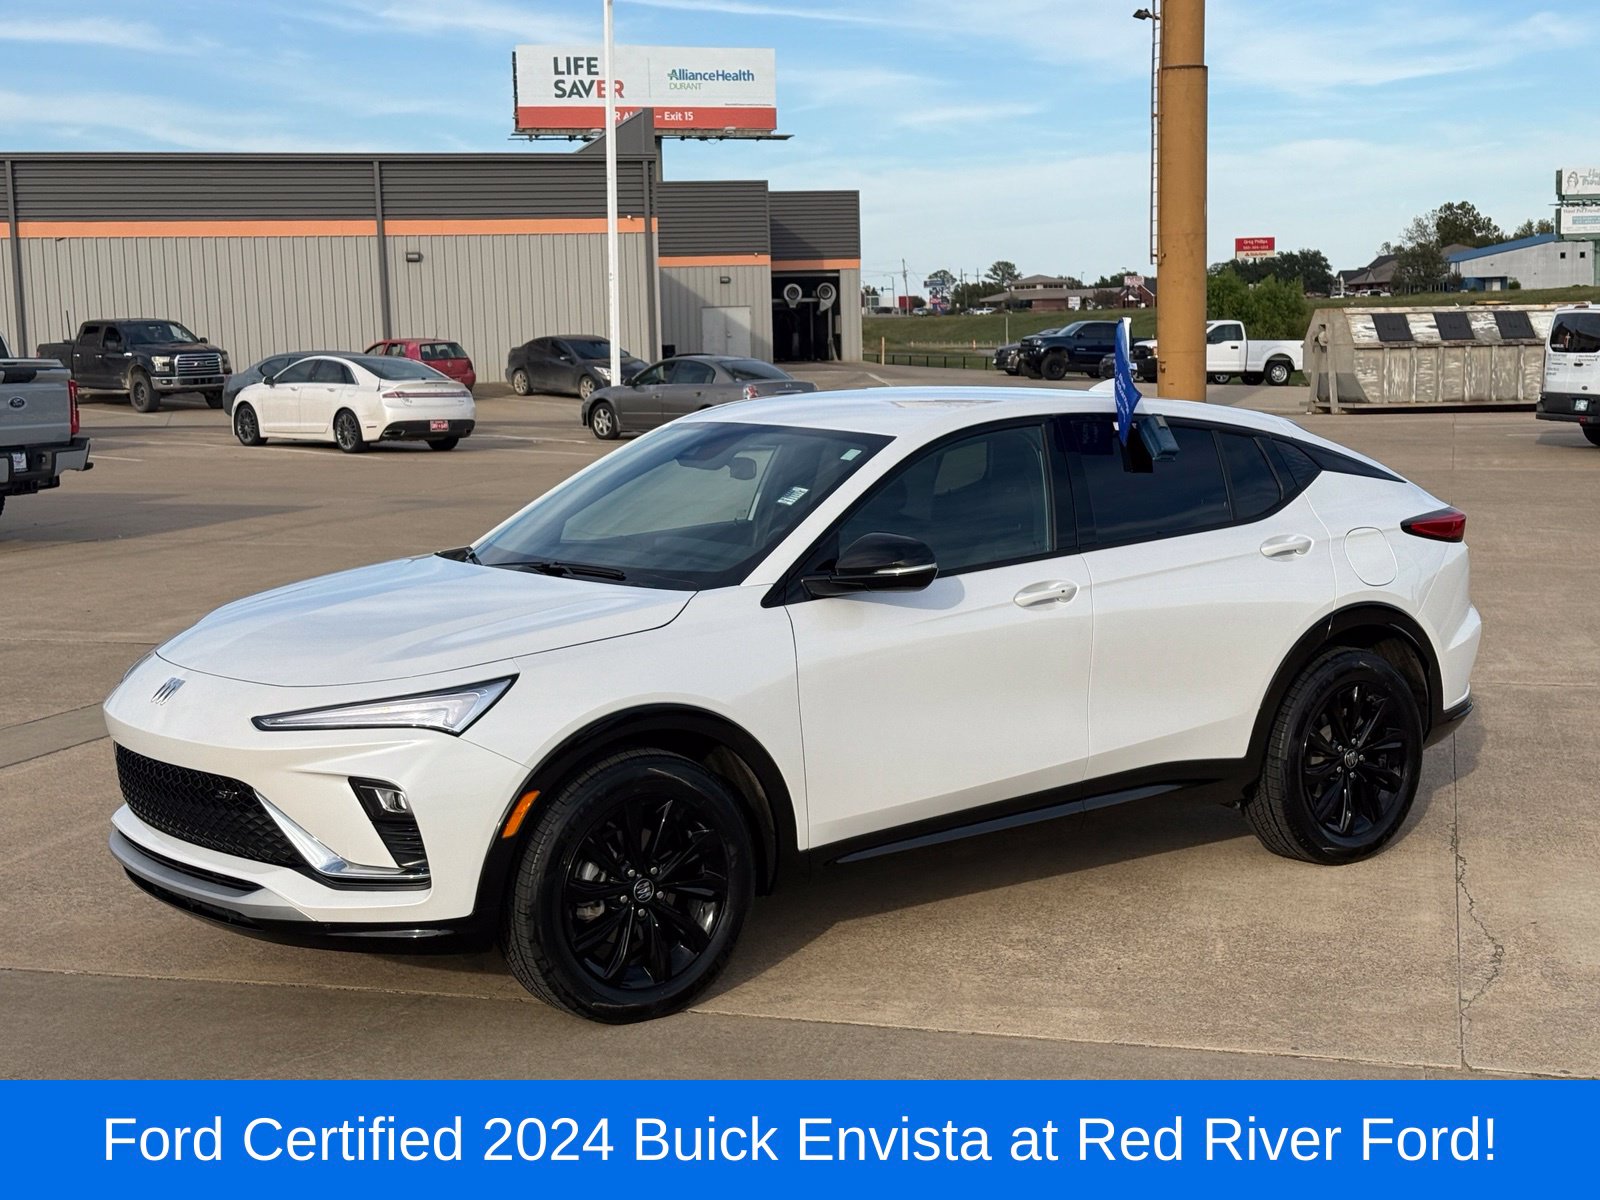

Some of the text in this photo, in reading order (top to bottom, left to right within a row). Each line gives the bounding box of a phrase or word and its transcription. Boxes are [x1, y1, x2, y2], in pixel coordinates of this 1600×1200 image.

[553, 56, 600, 76] LIFE
[667, 68, 755, 82] AllianceHealth
[553, 79, 625, 99] SAVER
[669, 82, 703, 90] DURANT
[664, 111, 682, 121] Exit
[684, 111, 694, 121] 15
